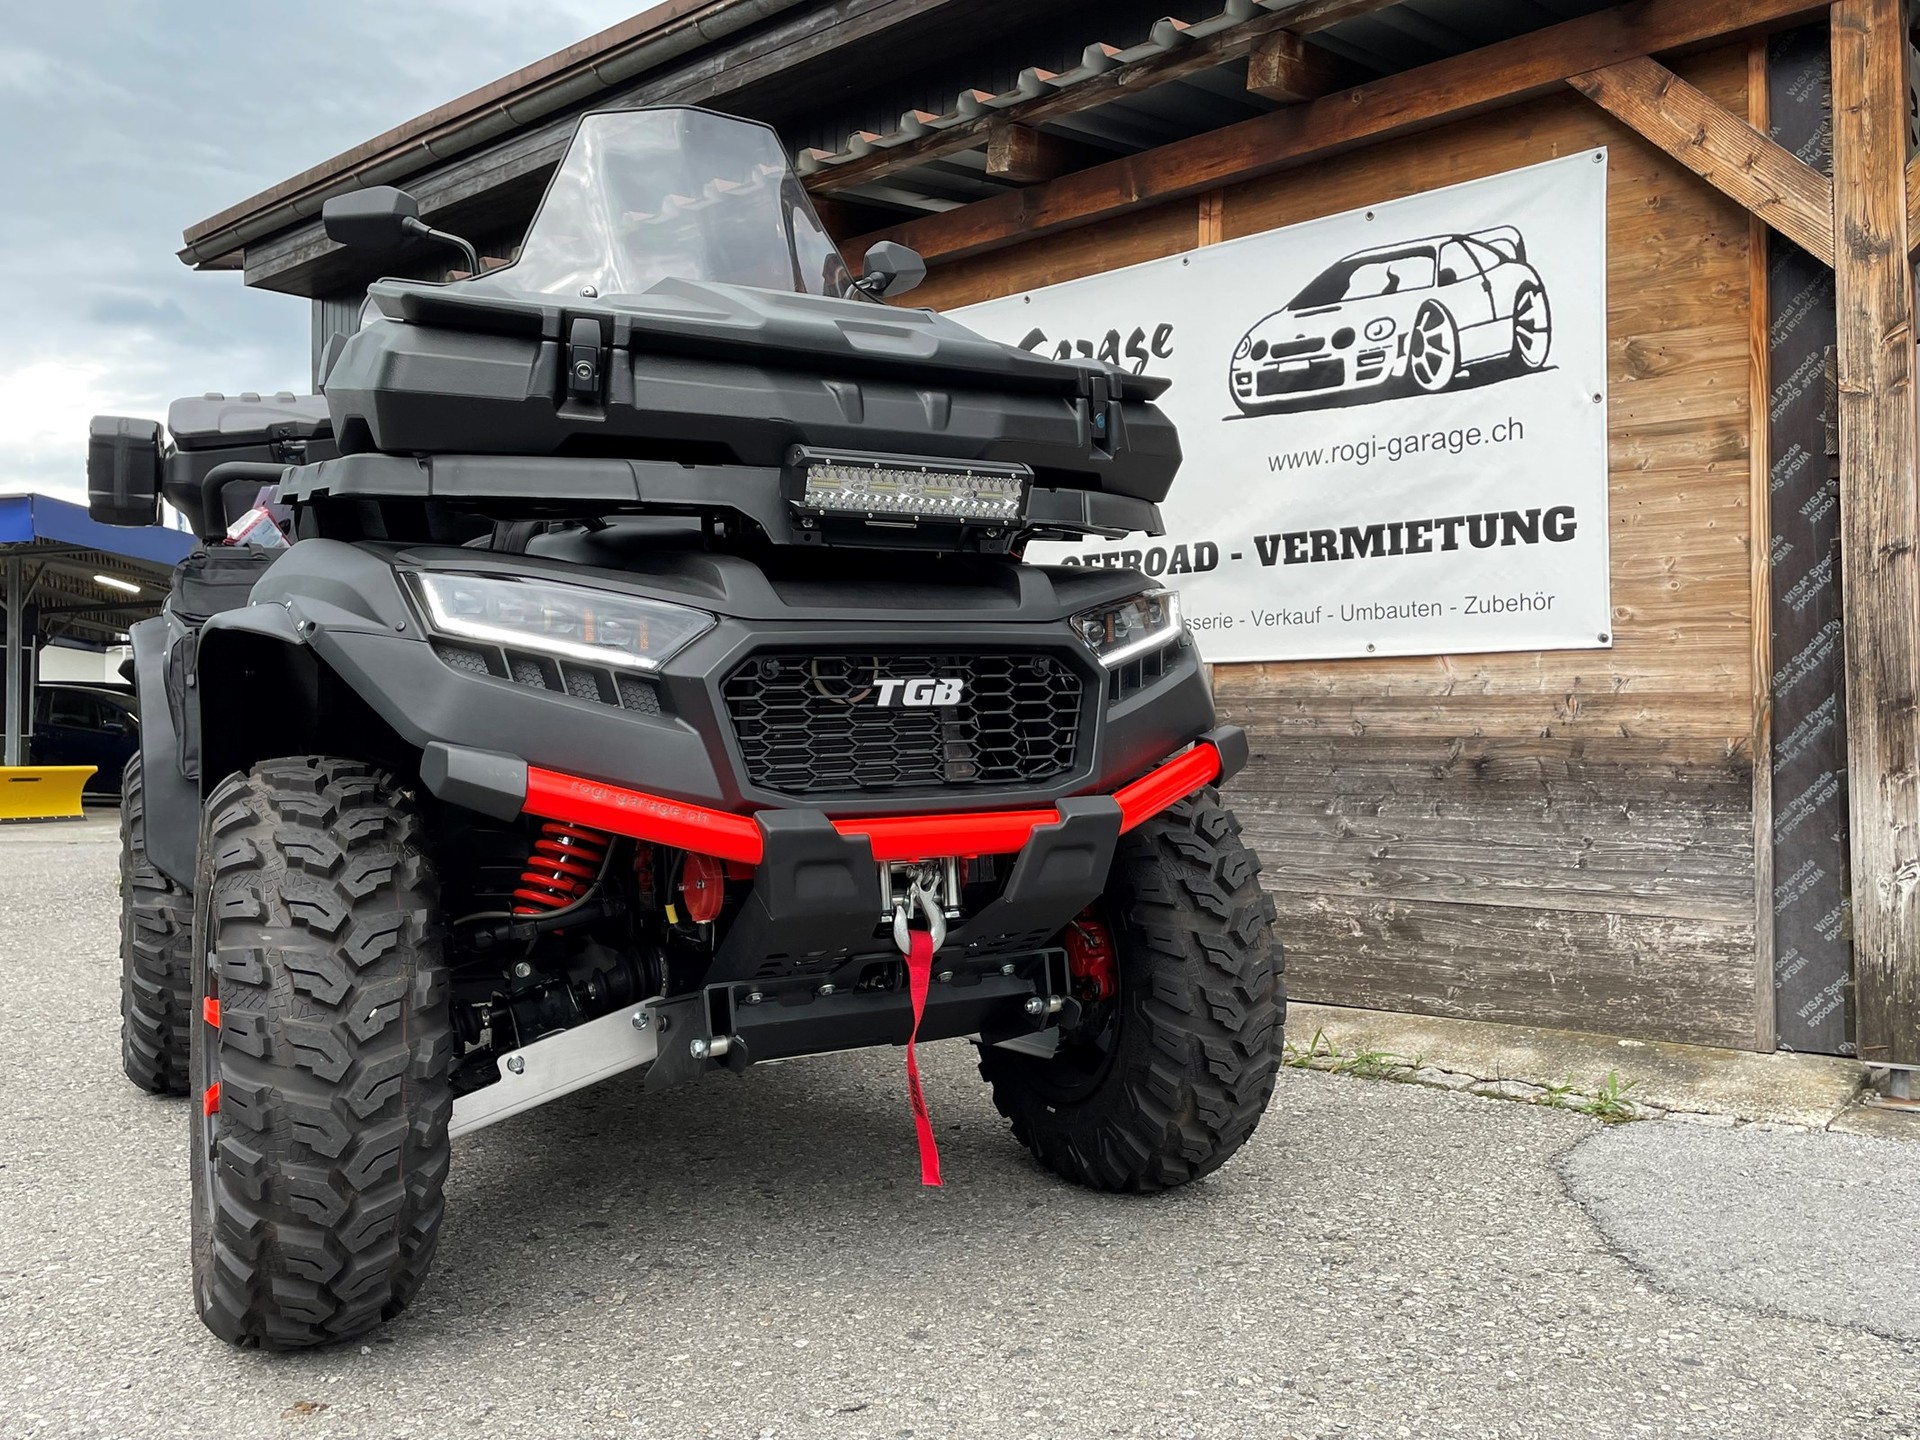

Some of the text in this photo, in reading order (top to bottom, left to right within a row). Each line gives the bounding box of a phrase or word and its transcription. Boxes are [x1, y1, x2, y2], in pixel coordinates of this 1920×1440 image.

[1775, 351, 1819, 396] Plywoods
[1771, 387, 1802, 423] Special
[1268, 416, 1524, 472] www.rogi-garage.ch
[1253, 505, 1578, 567] VERMIETUNG
[1808, 550, 1832, 578] Spec
[1250, 605, 1323, 627] Verkauf
[1340, 601, 1443, 622] Umbauten
[1463, 592, 1556, 615] Zubehör
[1791, 631, 1827, 665] Special
[873, 678, 964, 706] TGB
[1775, 657, 1820, 698] Plywoods
[1774, 692, 1836, 753] Special Plywo
[1788, 770, 1833, 810] Plywoods
[1782, 803, 1816, 835] Special
